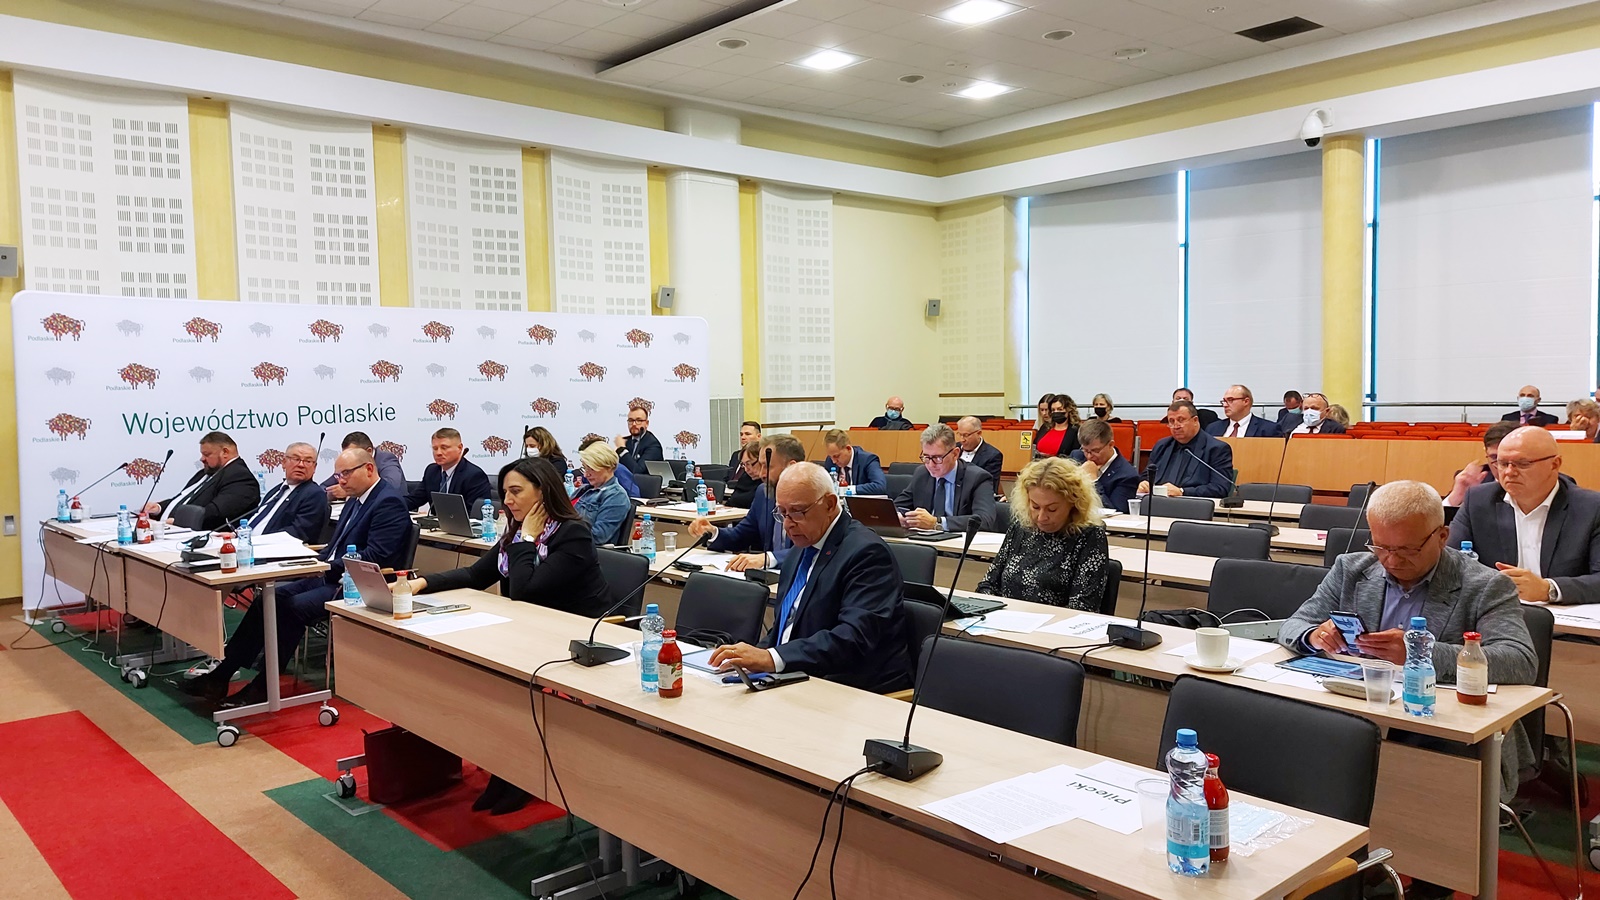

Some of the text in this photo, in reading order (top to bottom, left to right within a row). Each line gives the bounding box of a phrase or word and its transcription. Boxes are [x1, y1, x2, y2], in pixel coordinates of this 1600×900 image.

[122, 402, 396, 438] Województwo Podlaskie
[1066, 781, 1132, 805] Pilecki
